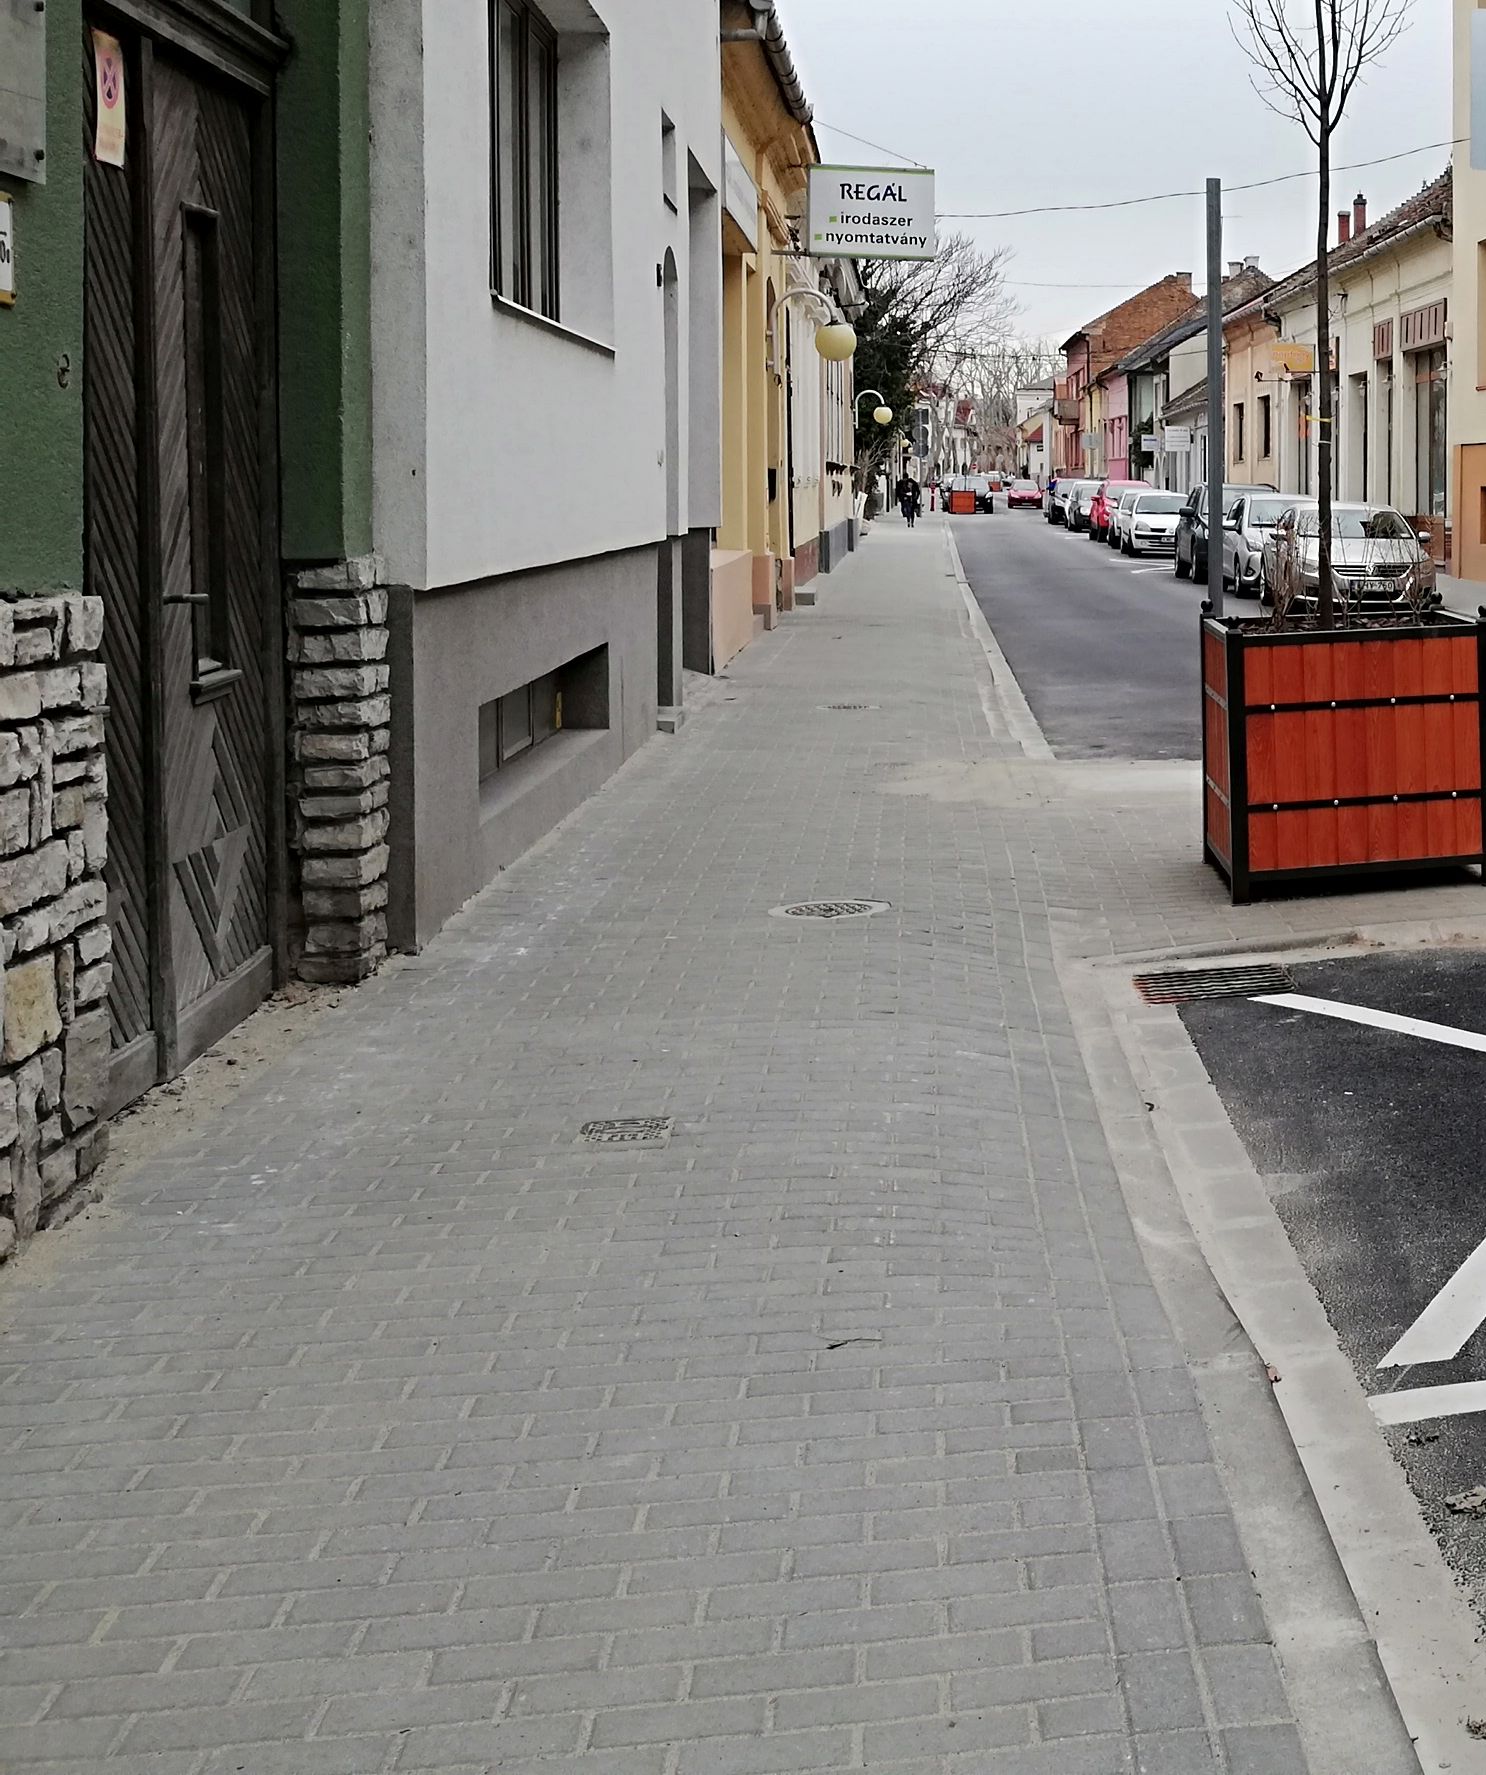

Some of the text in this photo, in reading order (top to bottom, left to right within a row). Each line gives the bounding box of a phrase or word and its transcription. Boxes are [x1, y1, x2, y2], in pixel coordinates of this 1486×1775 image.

[840, 182, 907, 202] REGÁL
[840, 211, 913, 227] irodaszer
[826, 231, 927, 248] nyomtatvány
